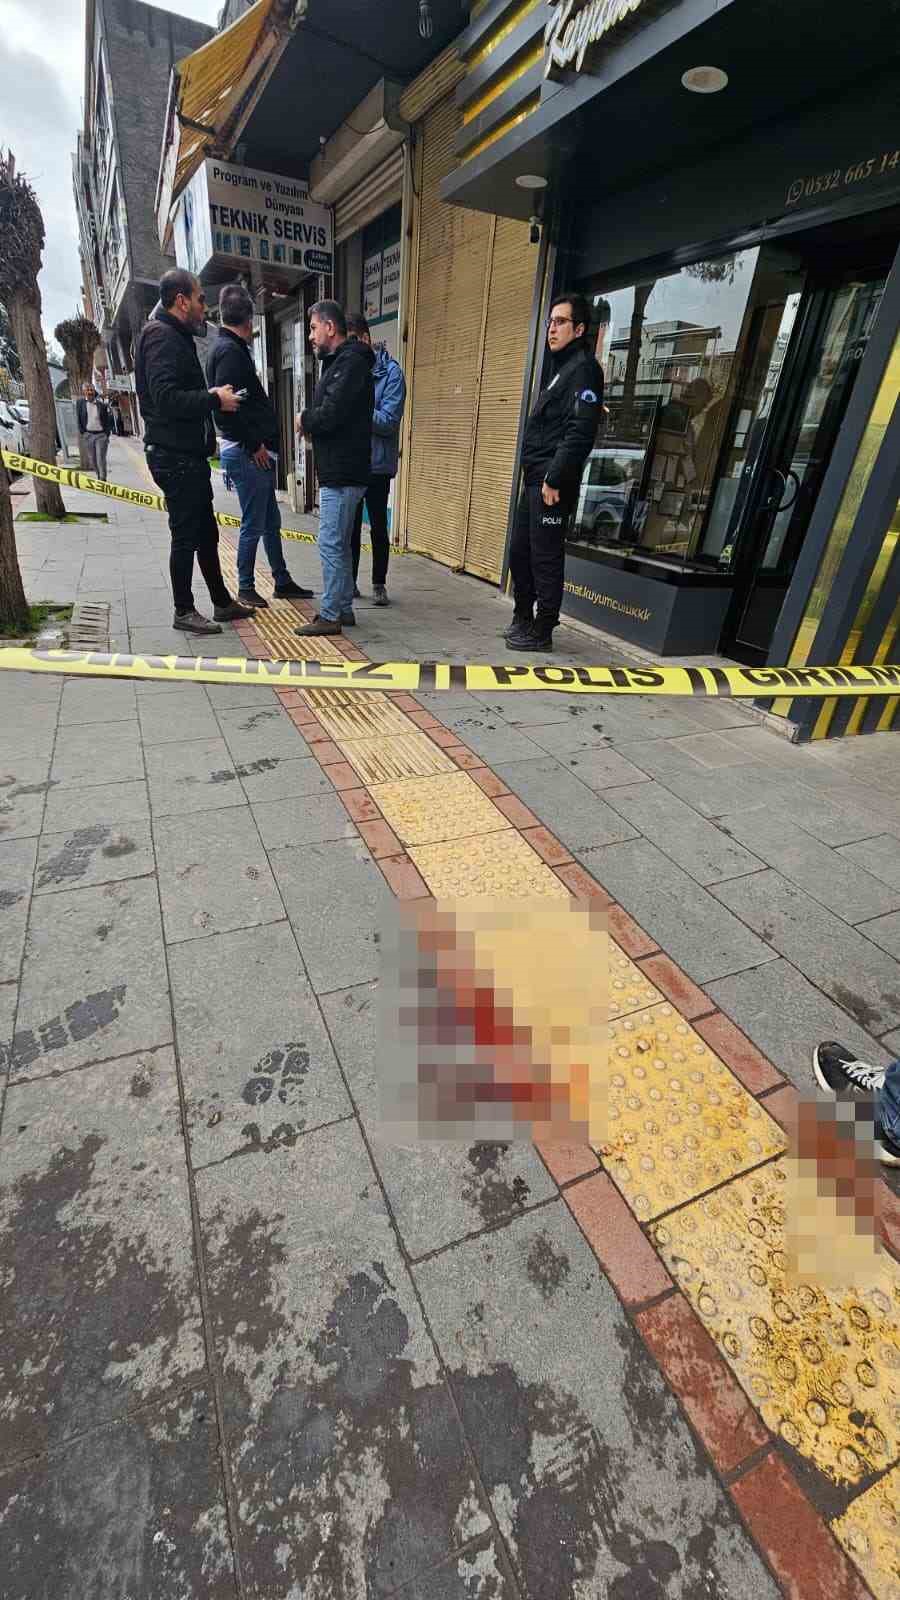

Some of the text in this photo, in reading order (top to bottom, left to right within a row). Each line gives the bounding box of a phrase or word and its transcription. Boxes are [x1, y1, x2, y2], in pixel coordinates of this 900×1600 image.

[213, 167, 258, 189] Program
[261, 182, 272, 192] ve
[804, 168, 841, 196] 0532
[844, 158, 876, 184] 665
[265, 197, 304, 217] Dünyası
